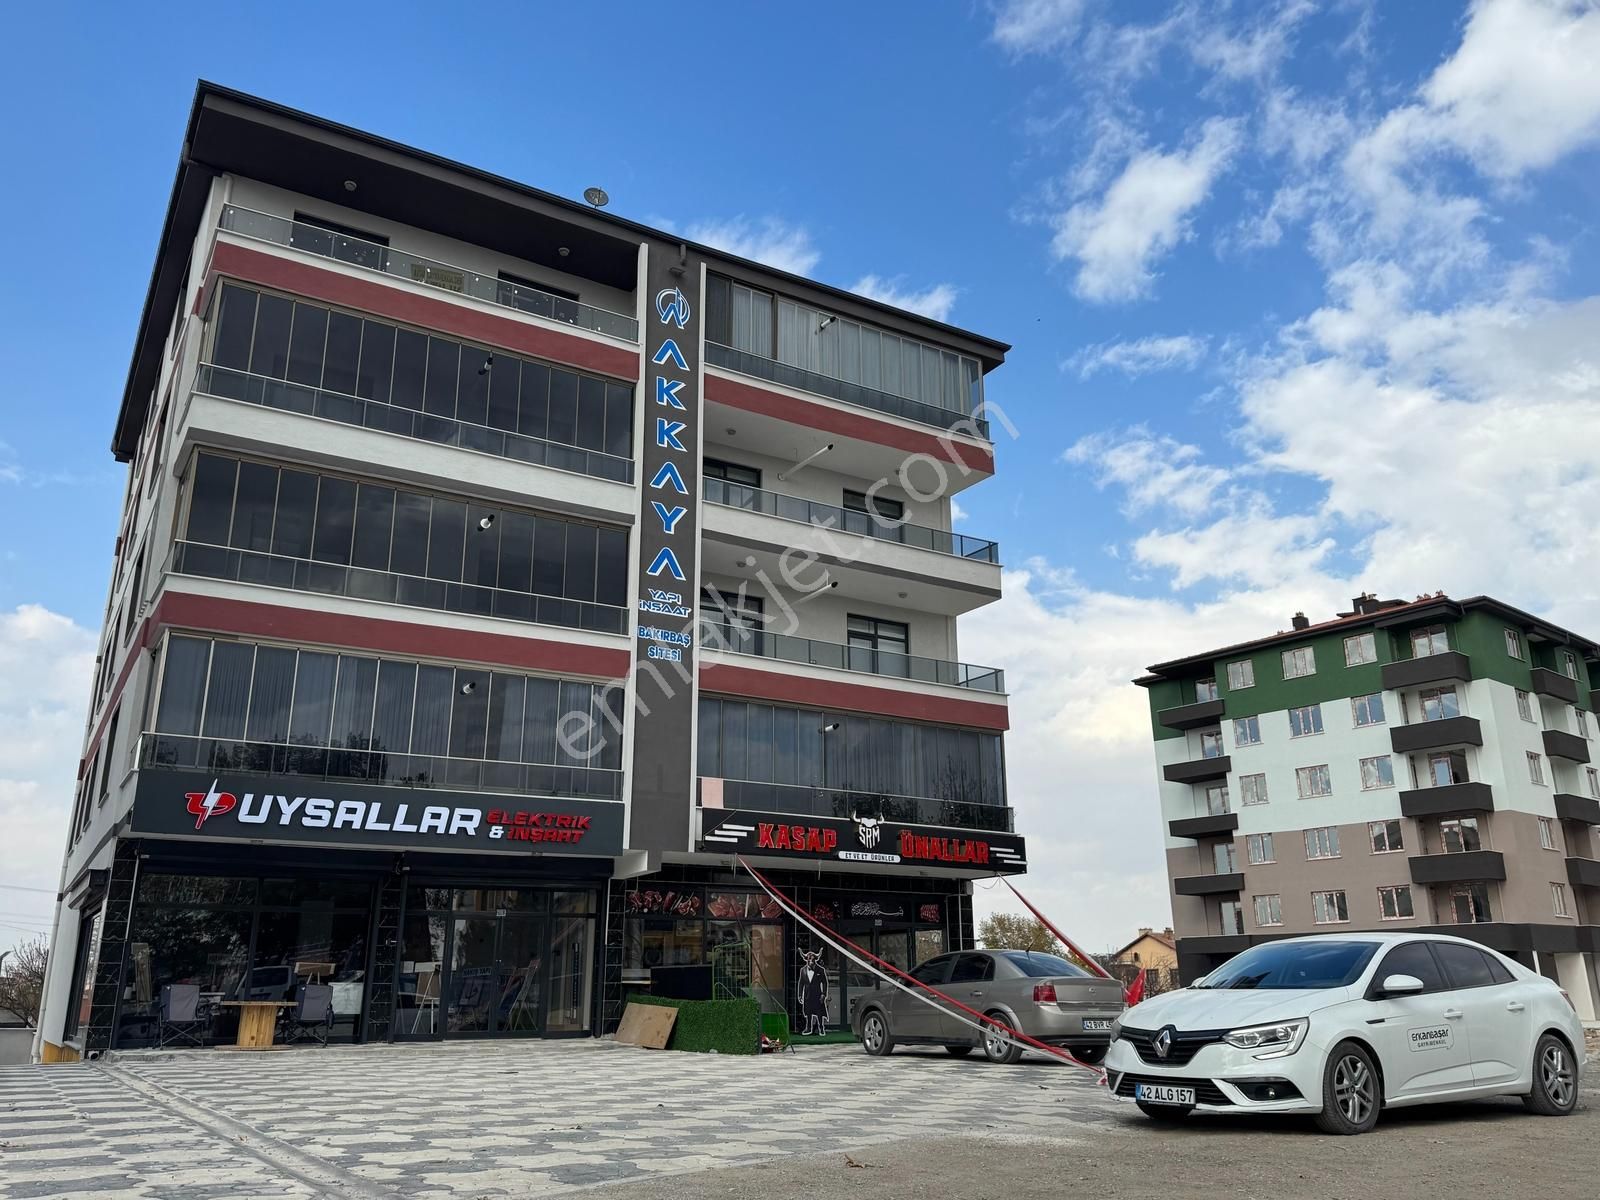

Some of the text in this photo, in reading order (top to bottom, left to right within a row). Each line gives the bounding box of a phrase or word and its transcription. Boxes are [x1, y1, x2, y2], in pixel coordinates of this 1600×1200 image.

[646, 338, 690, 581] AKKAYA
[648, 588, 682, 605] YAPI
[237, 793, 482, 836] UYSALLAR
[489, 825, 504, 839] &
[758, 822, 837, 853] KASAP
[859, 824, 880, 849] SRM
[899, 829, 989, 864] ÜNALLAR
[1140, 1086, 1193, 1103] 42 ALG 157
